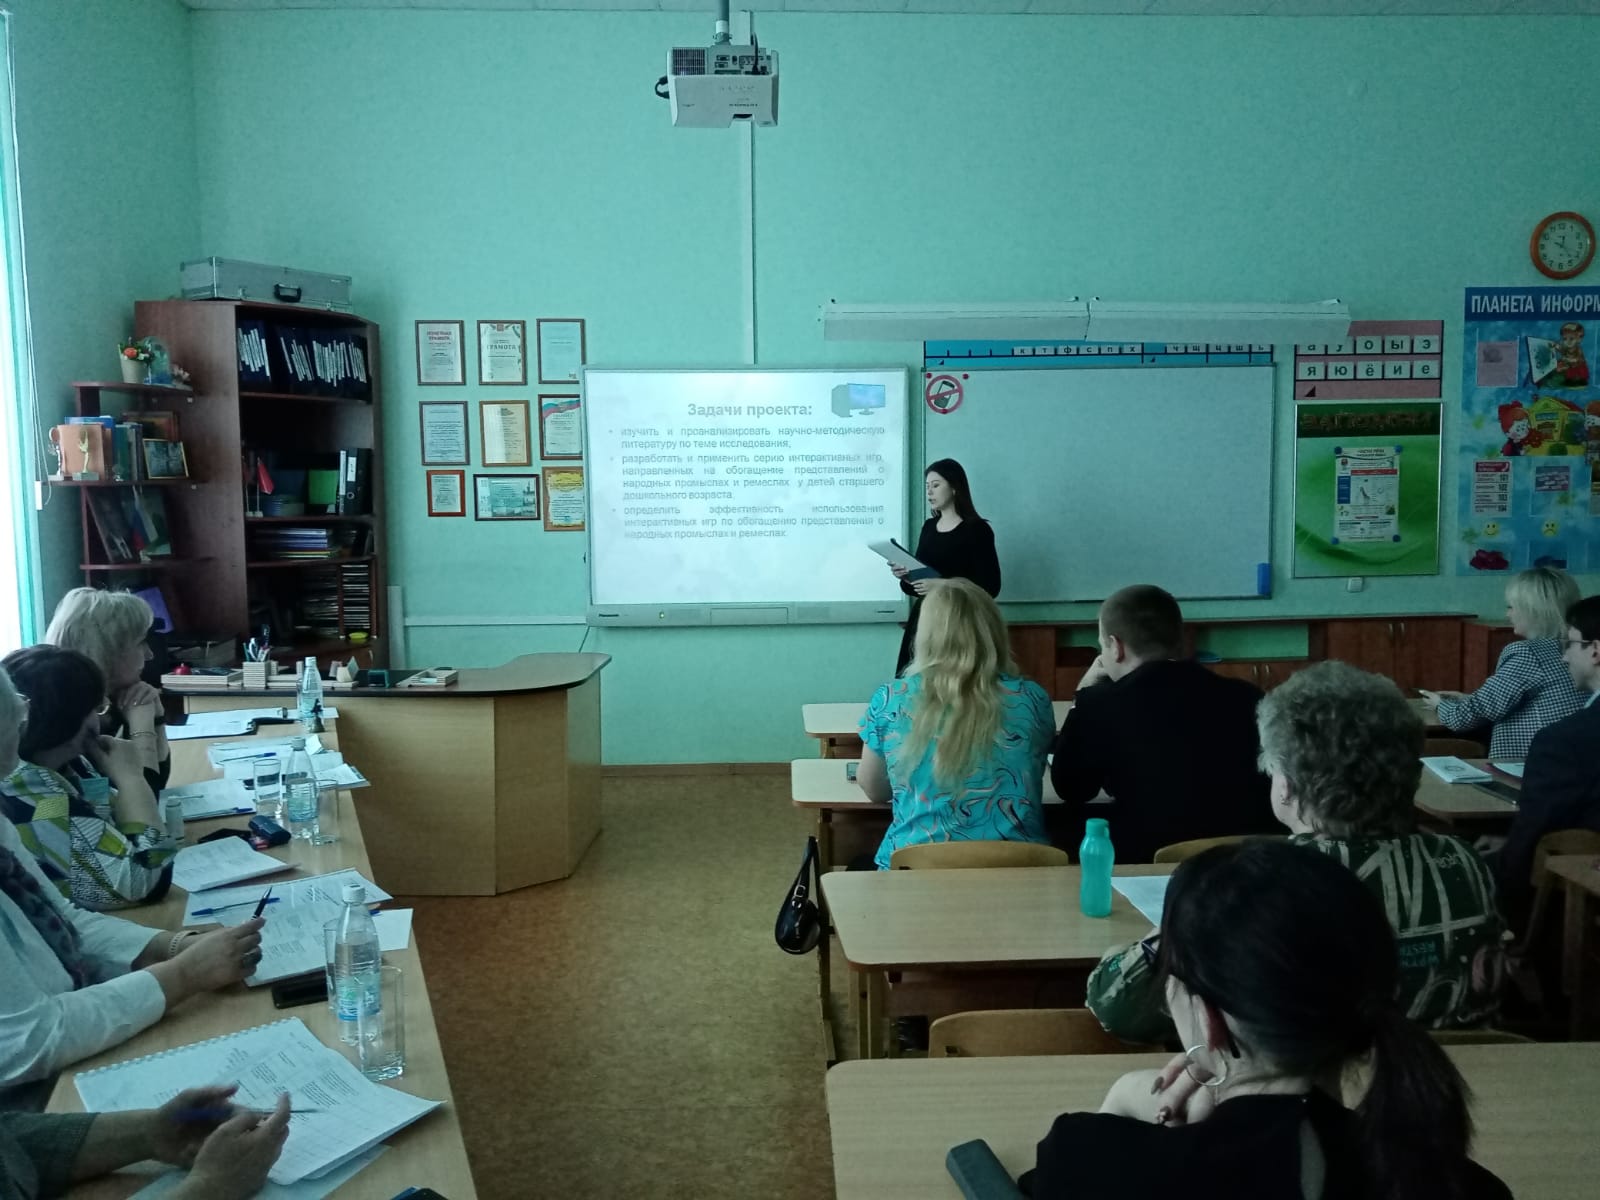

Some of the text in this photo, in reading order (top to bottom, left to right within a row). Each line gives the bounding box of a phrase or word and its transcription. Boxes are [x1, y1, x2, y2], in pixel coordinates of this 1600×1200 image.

[1471, 295, 1534, 313] ПЛАНЕТА
[1063, 345, 1072, 355] ф
[1363, 339, 1374, 350] о
[1390, 340, 1404, 350] ы
[1422, 339, 1431, 349] э
[1307, 364, 1430, 376] я ю ё и е
[687, 403, 813, 419] Задачи проекта:
[620, 426, 885, 438] изучить и проанализировать научно-методическую
[621, 440, 677, 450] литературу
[679, 440, 691, 448] по
[693, 440, 718, 448] теме
[621, 454, 682, 465] разработать
[697, 455, 750, 465] применить
[753, 454, 785, 464] серию
[788, 453, 861, 464] интерактивных
[622, 464, 885, 477] направленных на обогащение представлений о
[623, 479, 671, 489] народных
[674, 479, 729, 489] промыслах
[743, 478, 790, 488] ремеслах
[807, 477, 835, 488] детей
[838, 477, 885, 488] старшего
[622, 490, 687, 501] дошкольного
[624, 503, 884, 515] определить эффективность использования
[624, 517, 697, 528] интерактивных
[701, 516, 717, 528] игр
[721, 516, 733, 526] по
[737, 515, 797, 527] обогащению
[877, 516, 885, 525] о
[624, 529, 672, 540] народных
[674, 528, 729, 540] промыслах
